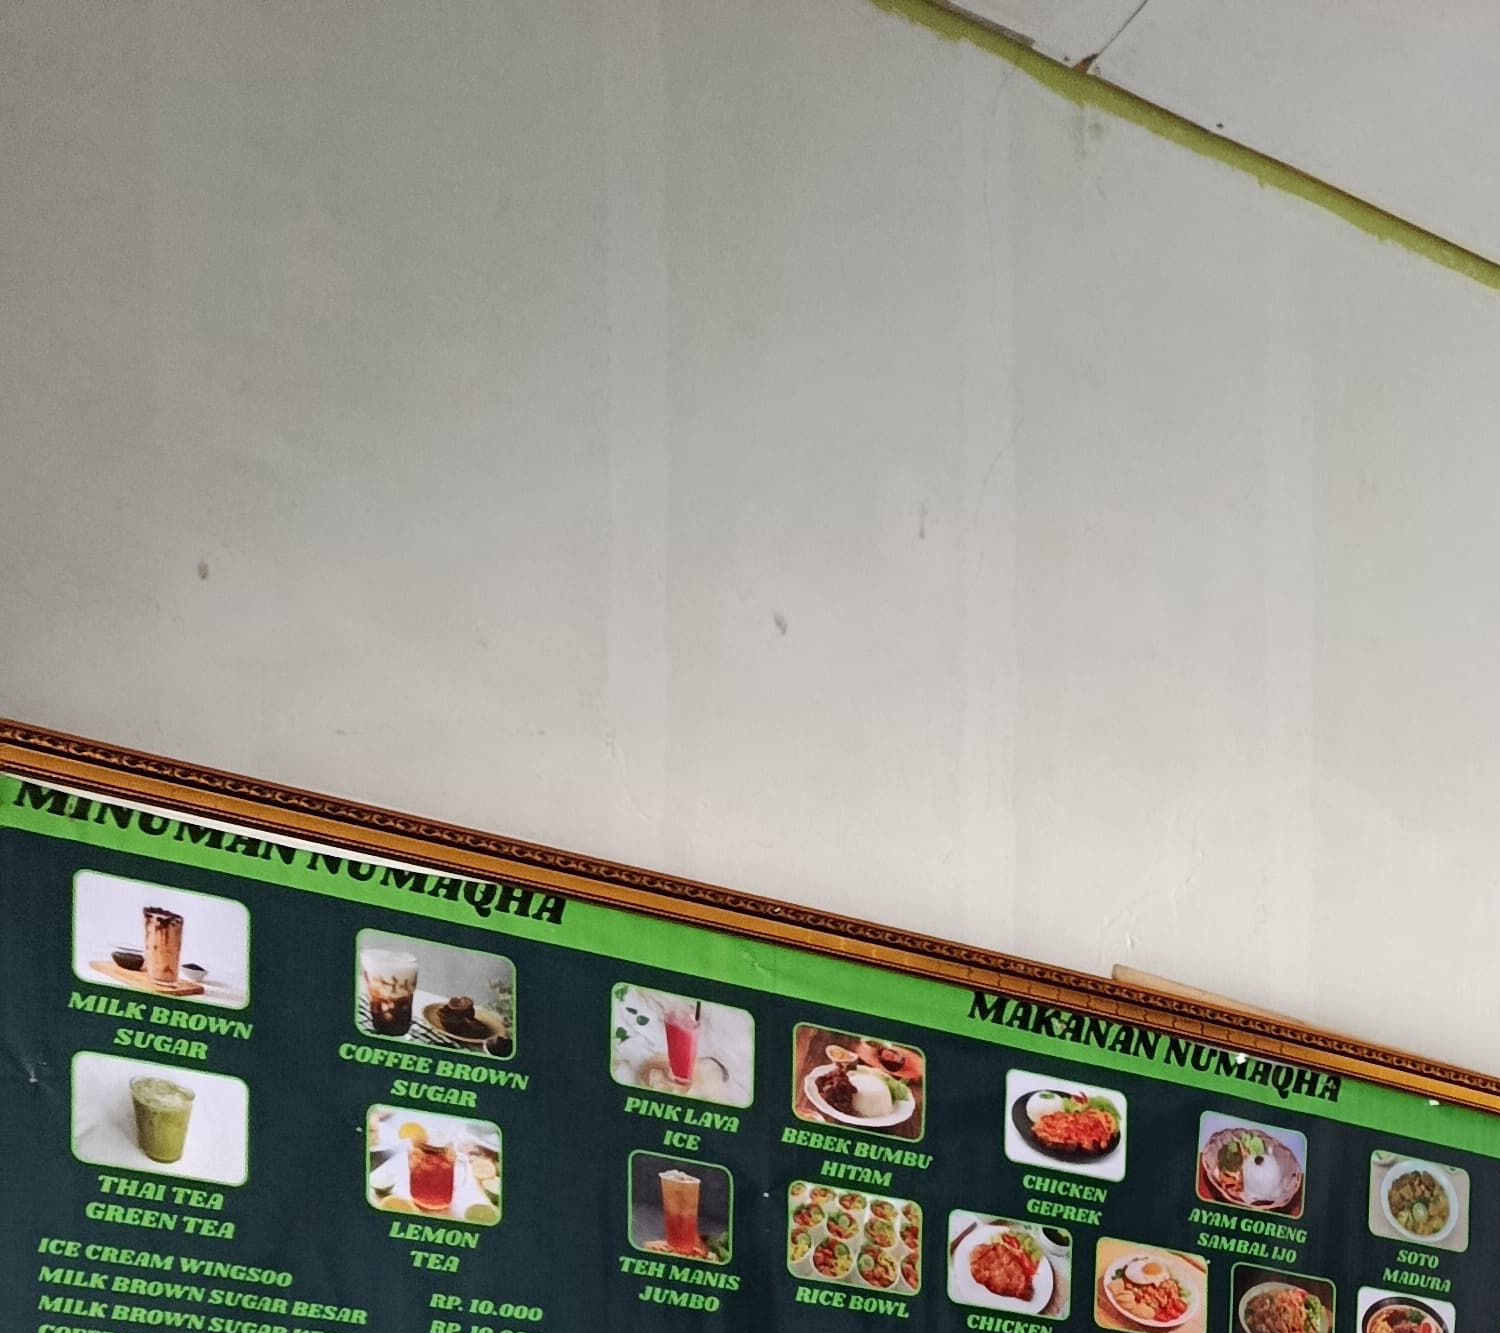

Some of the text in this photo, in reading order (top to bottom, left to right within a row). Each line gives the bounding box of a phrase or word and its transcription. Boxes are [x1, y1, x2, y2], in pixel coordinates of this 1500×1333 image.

[13, 781, 566, 924] MINUMAN NUMAQHA
[68, 992, 253, 1039] MILK BROWN
[114, 1029, 208, 1059] SUGAR
[968, 991, 1342, 1103] MAKANAN NUMAQHA
[339, 1043, 529, 1090] COFFEE BROWN
[391, 1080, 477, 1107] SUGAR
[624, 1097, 739, 1132] PINK LAVA
[664, 1130, 700, 1150] ICE
[781, 1127, 933, 1169] BEBEK BUMBU
[821, 1161, 892, 1186] HITAM
[1023, 1175, 1107, 1202] CHICKEN
[98, 1175, 223, 1210] THAI TEA
[86, 1202, 235, 1239] GREEN TEA
[1027, 1199, 1102, 1225] GEPREK
[1189, 1208, 1307, 1243] AYAM GORENG
[389, 1222, 479, 1248] LEMON
[1197, 1233, 1296, 1263] SAMBAL IJO
[38, 1238, 292, 1287] ICE CREAM WINGSOO
[410, 1251, 459, 1272] TEA
[619, 1256, 740, 1290] TEH MANIS
[1397, 1250, 1439, 1268] SOTO
[39, 1266, 367, 1324] MILK BROWN SUGAR BESAR
[1383, 1268, 1451, 1292] MADURA
[38, 1296, 108, 1318] MILK
[111, 1305, 205, 1329] BROWN
[430, 1294, 543, 1321] RP. 10.000
[639, 1286, 720, 1312] JUMBO
[796, 1286, 909, 1318] RICE BOWL
